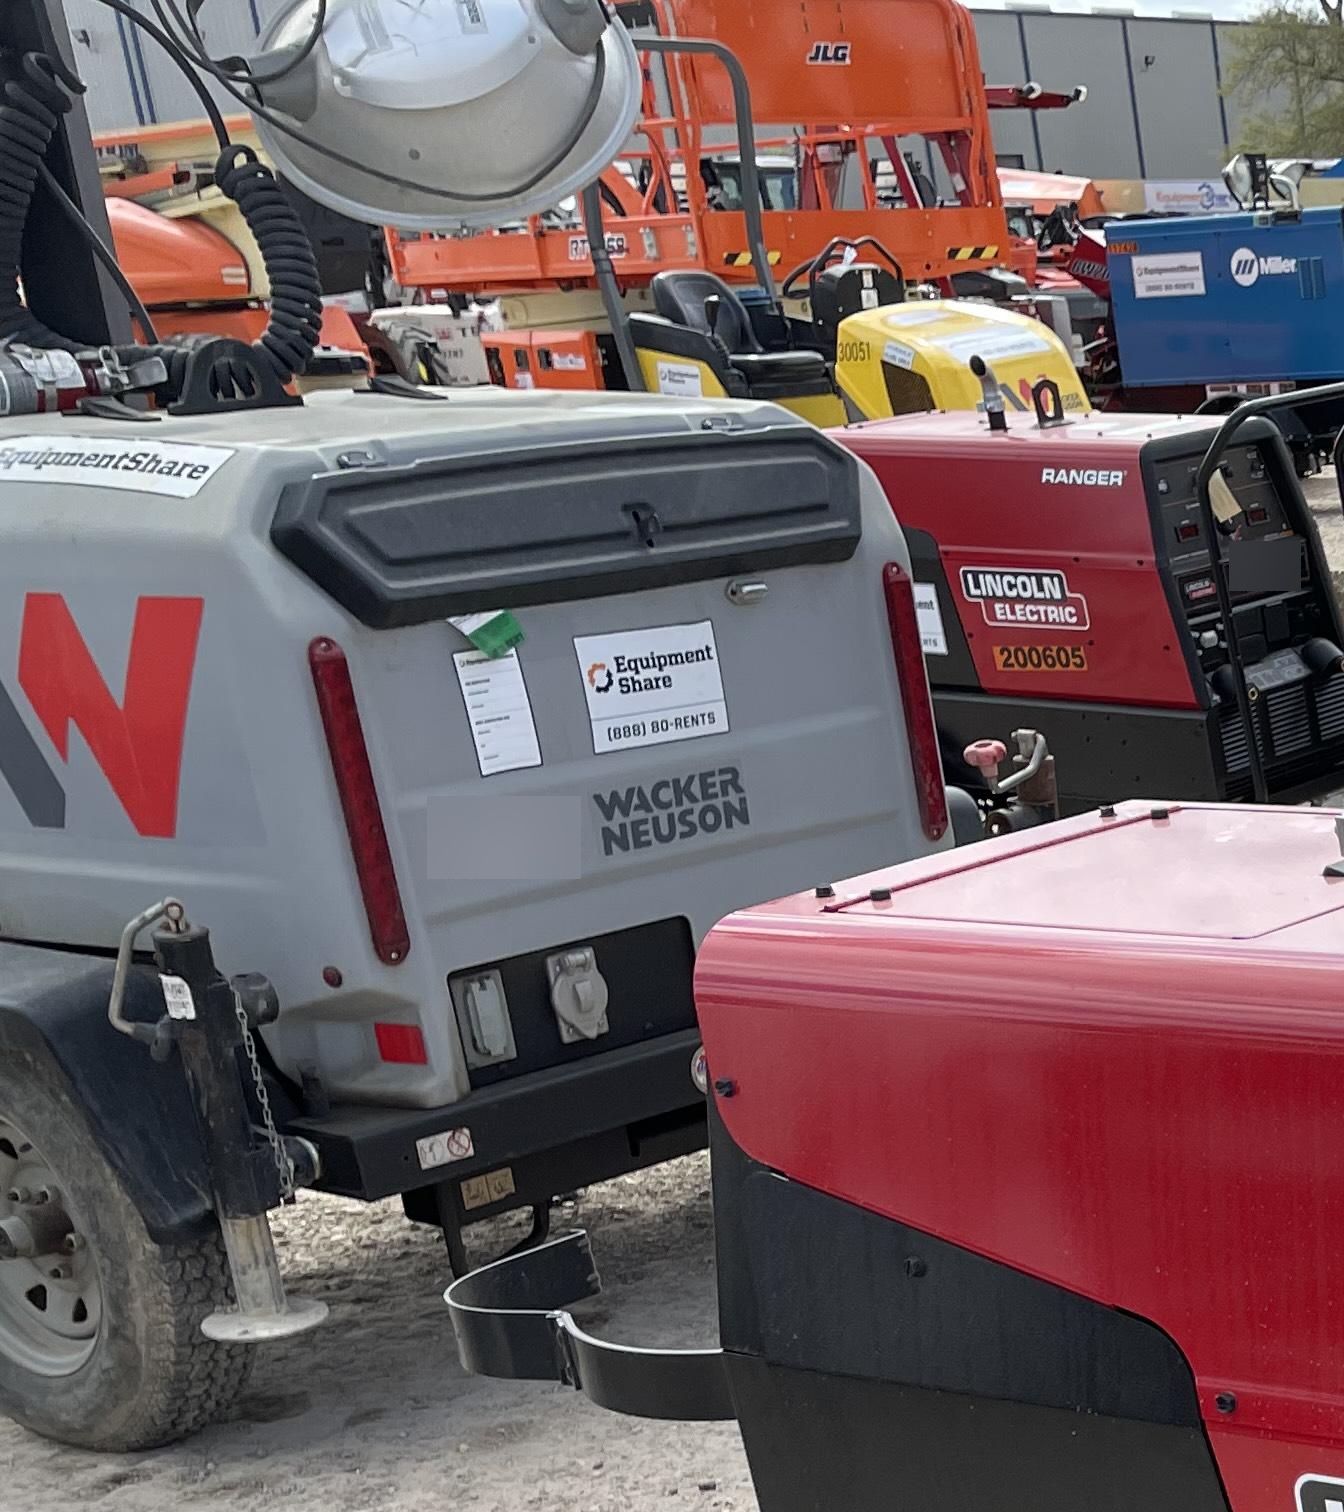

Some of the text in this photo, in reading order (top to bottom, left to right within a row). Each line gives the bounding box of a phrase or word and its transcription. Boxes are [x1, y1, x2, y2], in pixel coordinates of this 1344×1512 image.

[808, 44, 849, 63] JLG
[1259, 256, 1298, 275] Miller
[838, 340, 872, 363] 30051
[1041, 467, 1124, 487] RANGER
[966, 567, 1063, 600] LINCOLN
[993, 602, 1078, 624] ELECTRIC
[613, 643, 714, 674] Equipment
[999, 646, 1086, 671] 200605
[617, 673, 673, 695] Share
[606, 711, 716, 742] (888) 80-RENTS
[592, 766, 745, 822] WACKER
[601, 796, 750, 857] NEUSON
